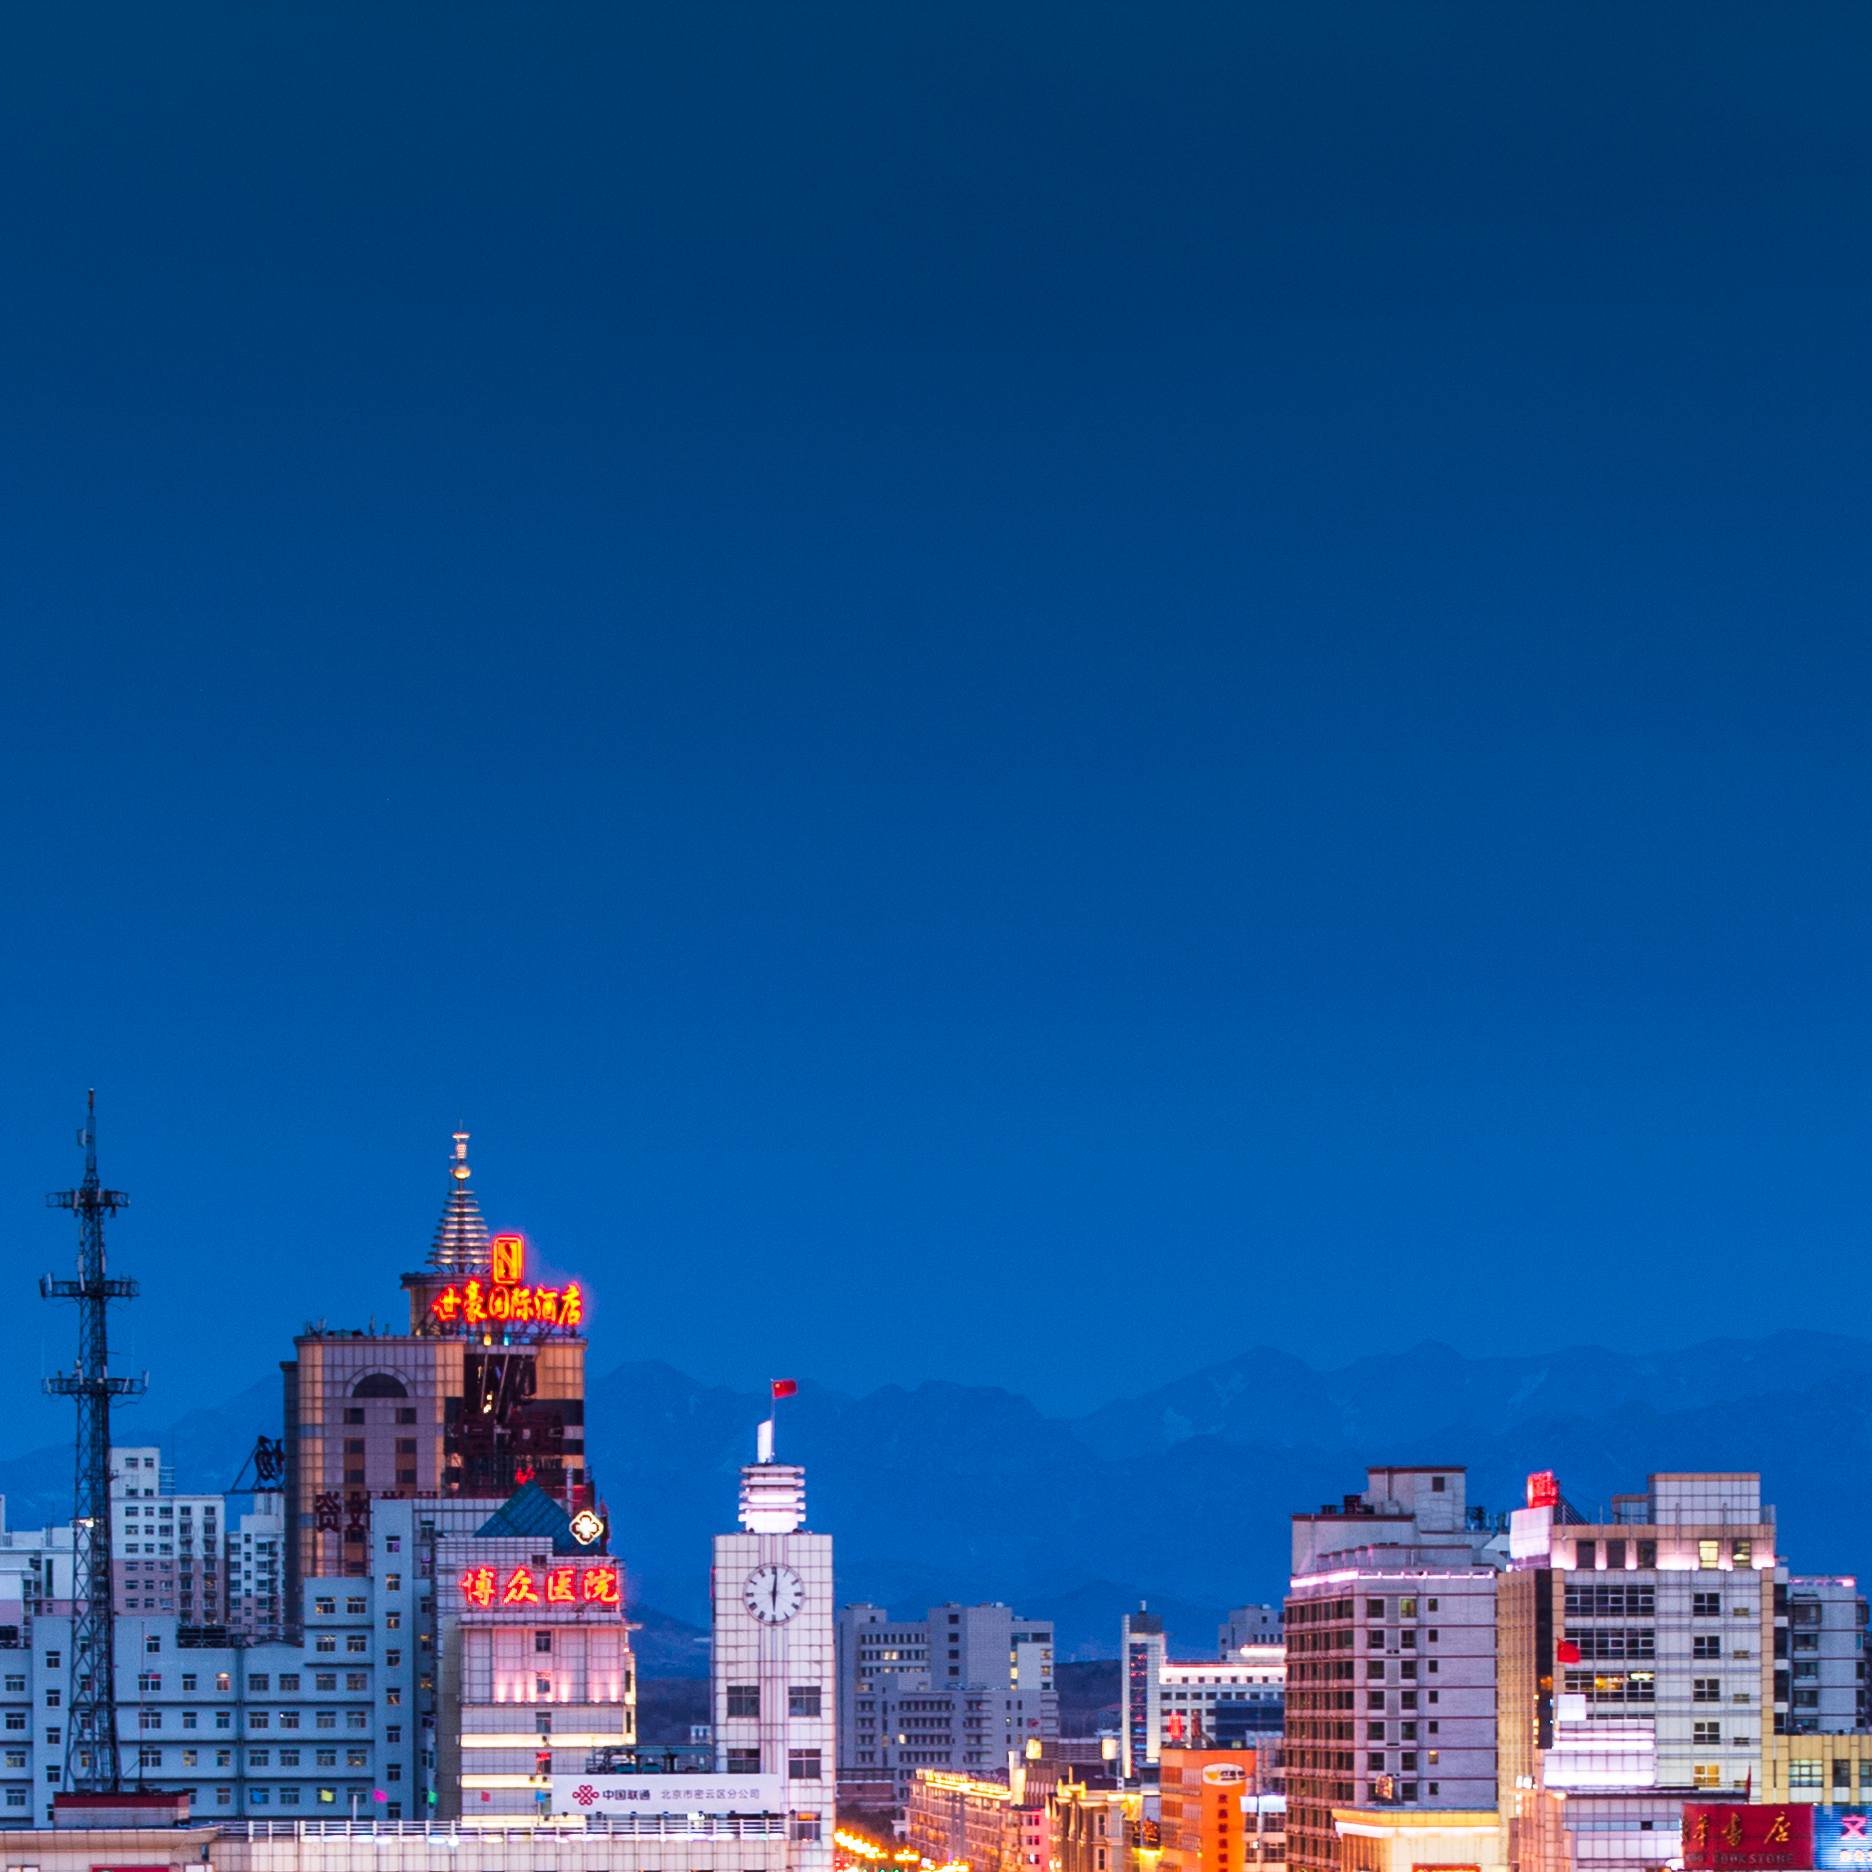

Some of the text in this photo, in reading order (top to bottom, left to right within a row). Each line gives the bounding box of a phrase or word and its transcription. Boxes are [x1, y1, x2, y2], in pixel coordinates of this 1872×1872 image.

[431, 1277, 582, 1325] 世豪国际酒店
[460, 1566, 622, 1608] 博众医院
[602, 1788, 760, 1801] 中国联通 北京市密云区分公司
